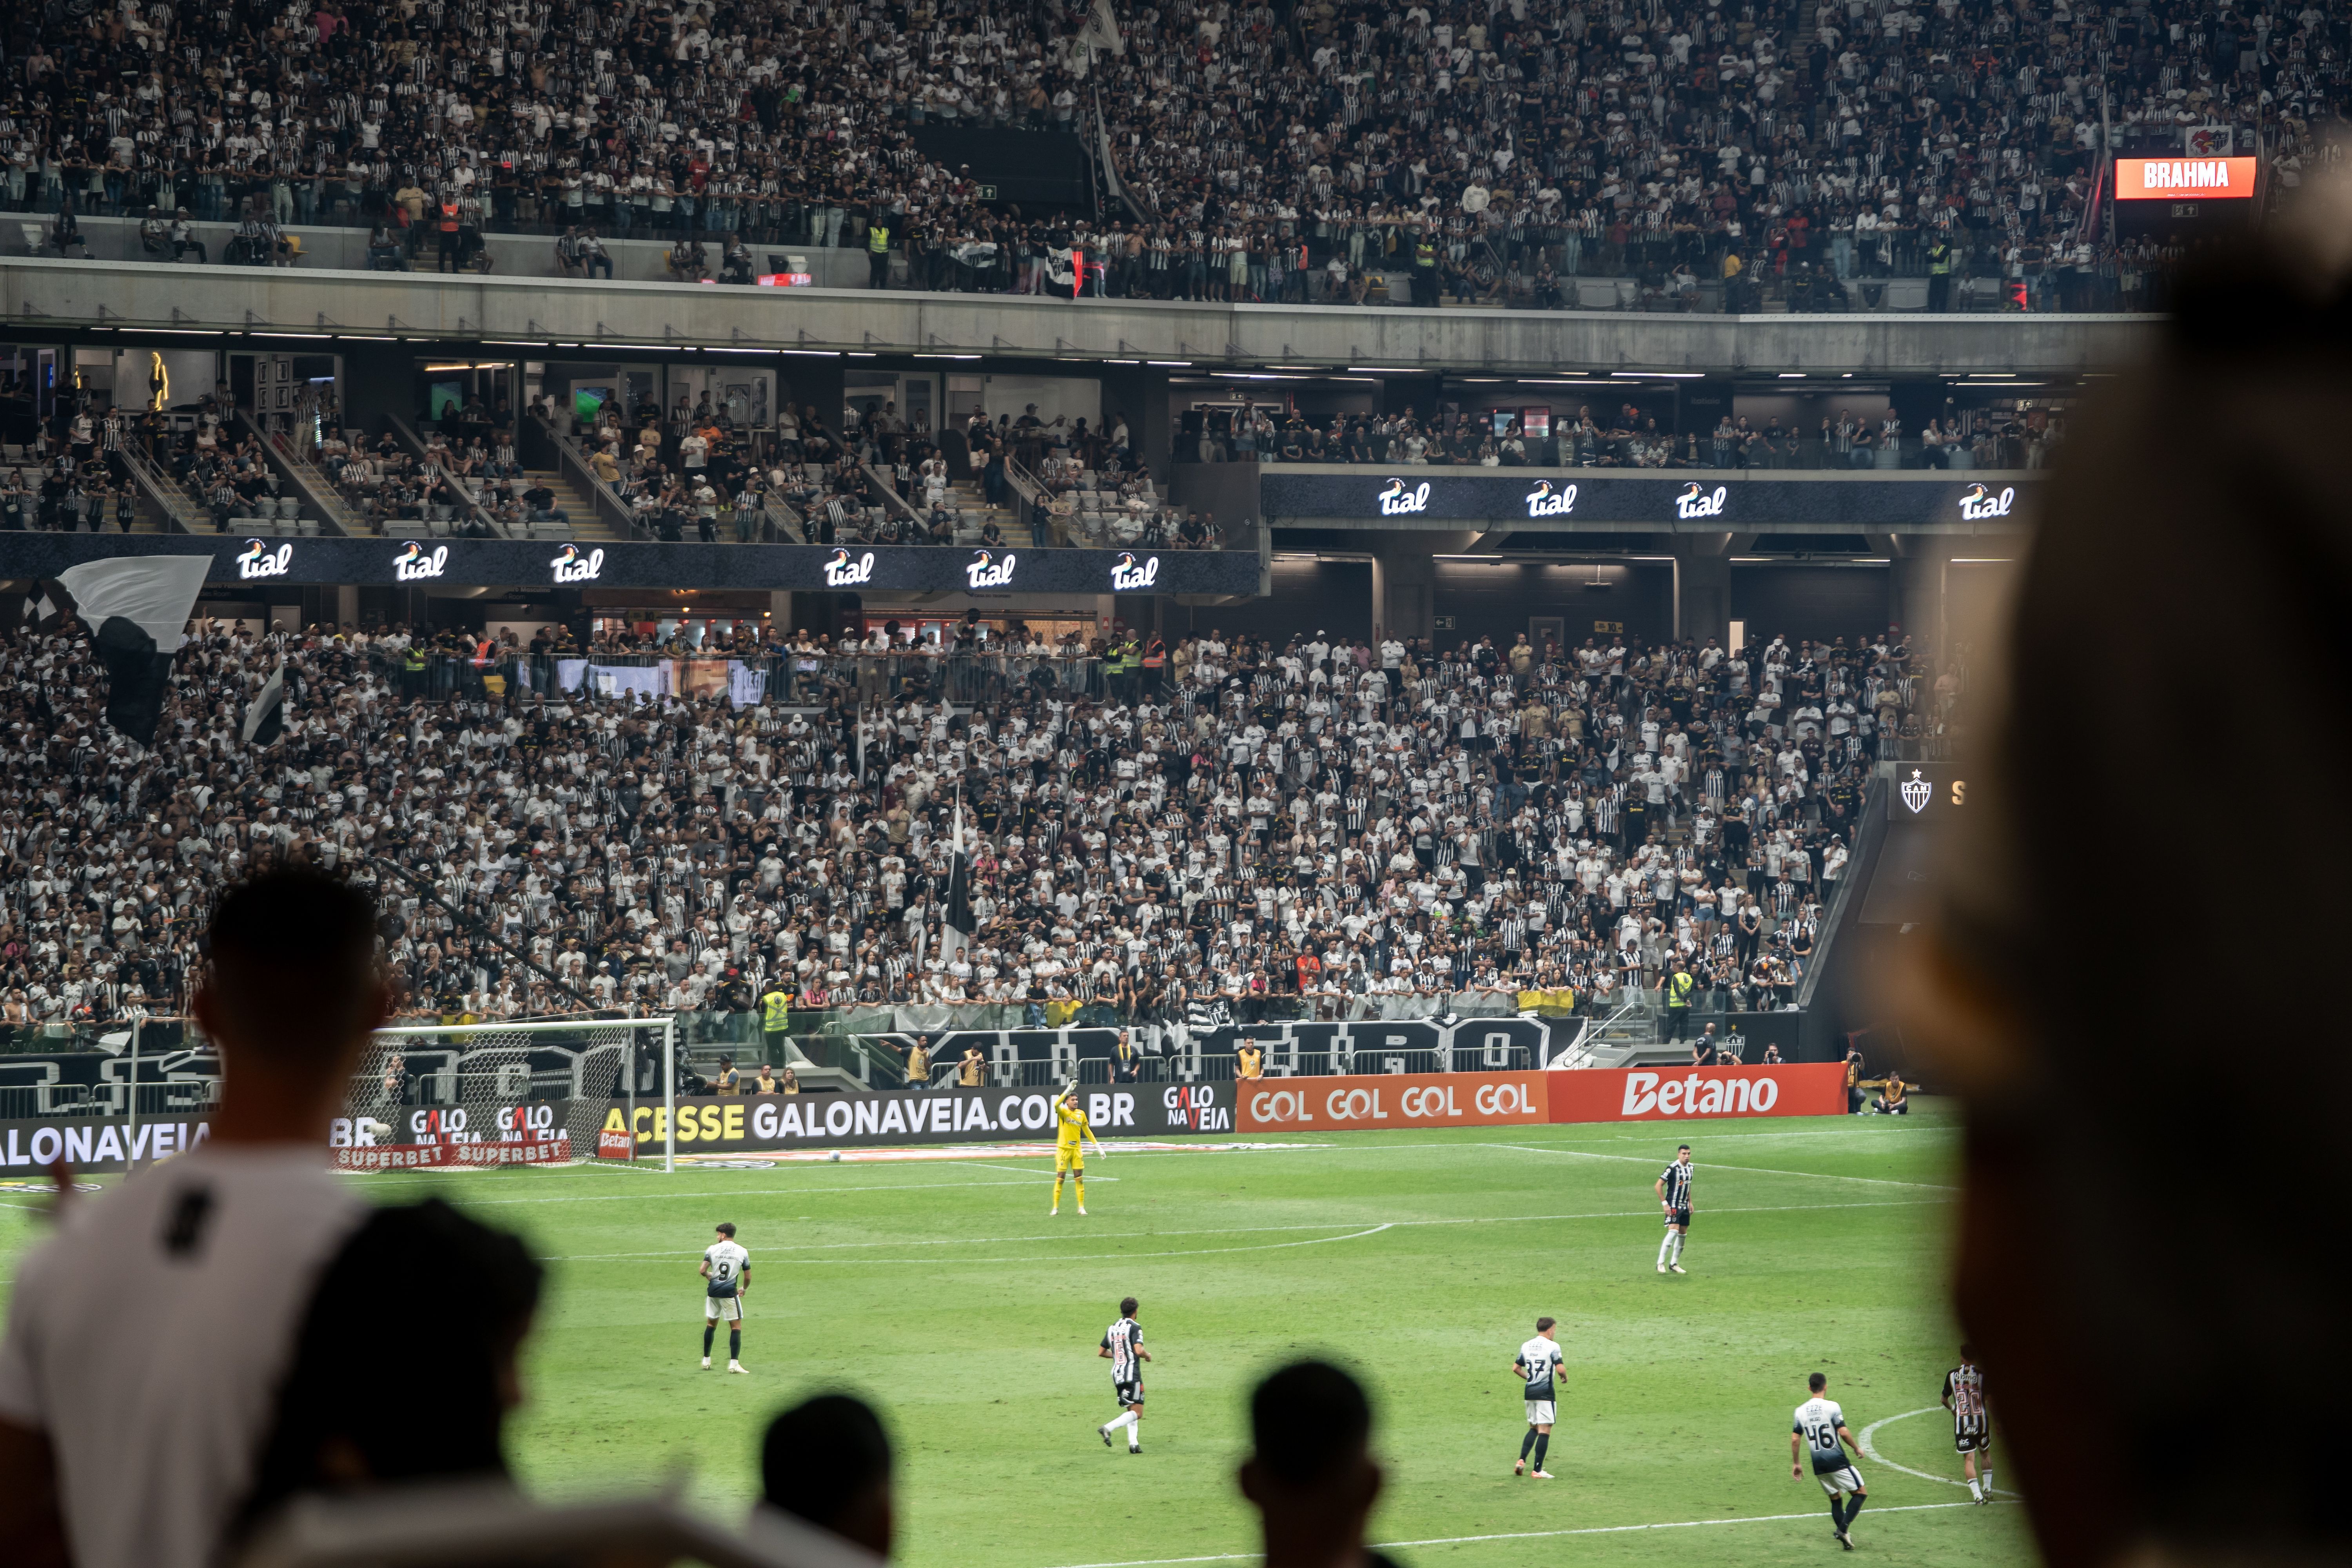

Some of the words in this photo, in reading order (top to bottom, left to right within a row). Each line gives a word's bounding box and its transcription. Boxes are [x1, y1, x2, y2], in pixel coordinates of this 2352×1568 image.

[2144, 162, 2229, 188] BRAHMA
[1379, 482, 1430, 515] Tial
[1526, 484, 1577, 517] Tial
[1676, 486, 1726, 519] Tial
[1959, 487, 2014, 520] Tial
[238, 543, 292, 579] Tial
[394, 545, 448, 581] Tial
[550, 548, 604, 583] Tial
[824, 552, 874, 586] Tial
[967, 554, 1015, 588] Tial
[1111, 556, 1158, 590] Tial
[1163, 1085, 1214, 1109] GALO
[1251, 1091, 1313, 1122] GOL
[1327, 1089, 1388, 1120] GOL
[1401, 1086, 1463, 1117] GOL
[1475, 1083, 1536, 1114] GOL
[1622, 1073, 1779, 1115] Betano
[410, 1108, 467, 1134] GALO
[497, 1105, 553, 1131] GALO
[604, 1104, 744, 1142] ACESSE
[753, 1093, 1135, 1140] GALONAVEIA.COBR
[338, 1145, 443, 1167] SUPERBET
[459, 1141, 563, 1163] SUPERBET
[600, 1132, 634, 1149] Betan
[719, 1261, 731, 1282] 9
[1115, 1341, 1127, 1365] 6
[1526, 1359, 1546, 1383] 37
[1960, 1373, 1978, 1383] bmg
[1956, 1389, 1982, 1416] 20
[1804, 1423, 1836, 1451] 46
